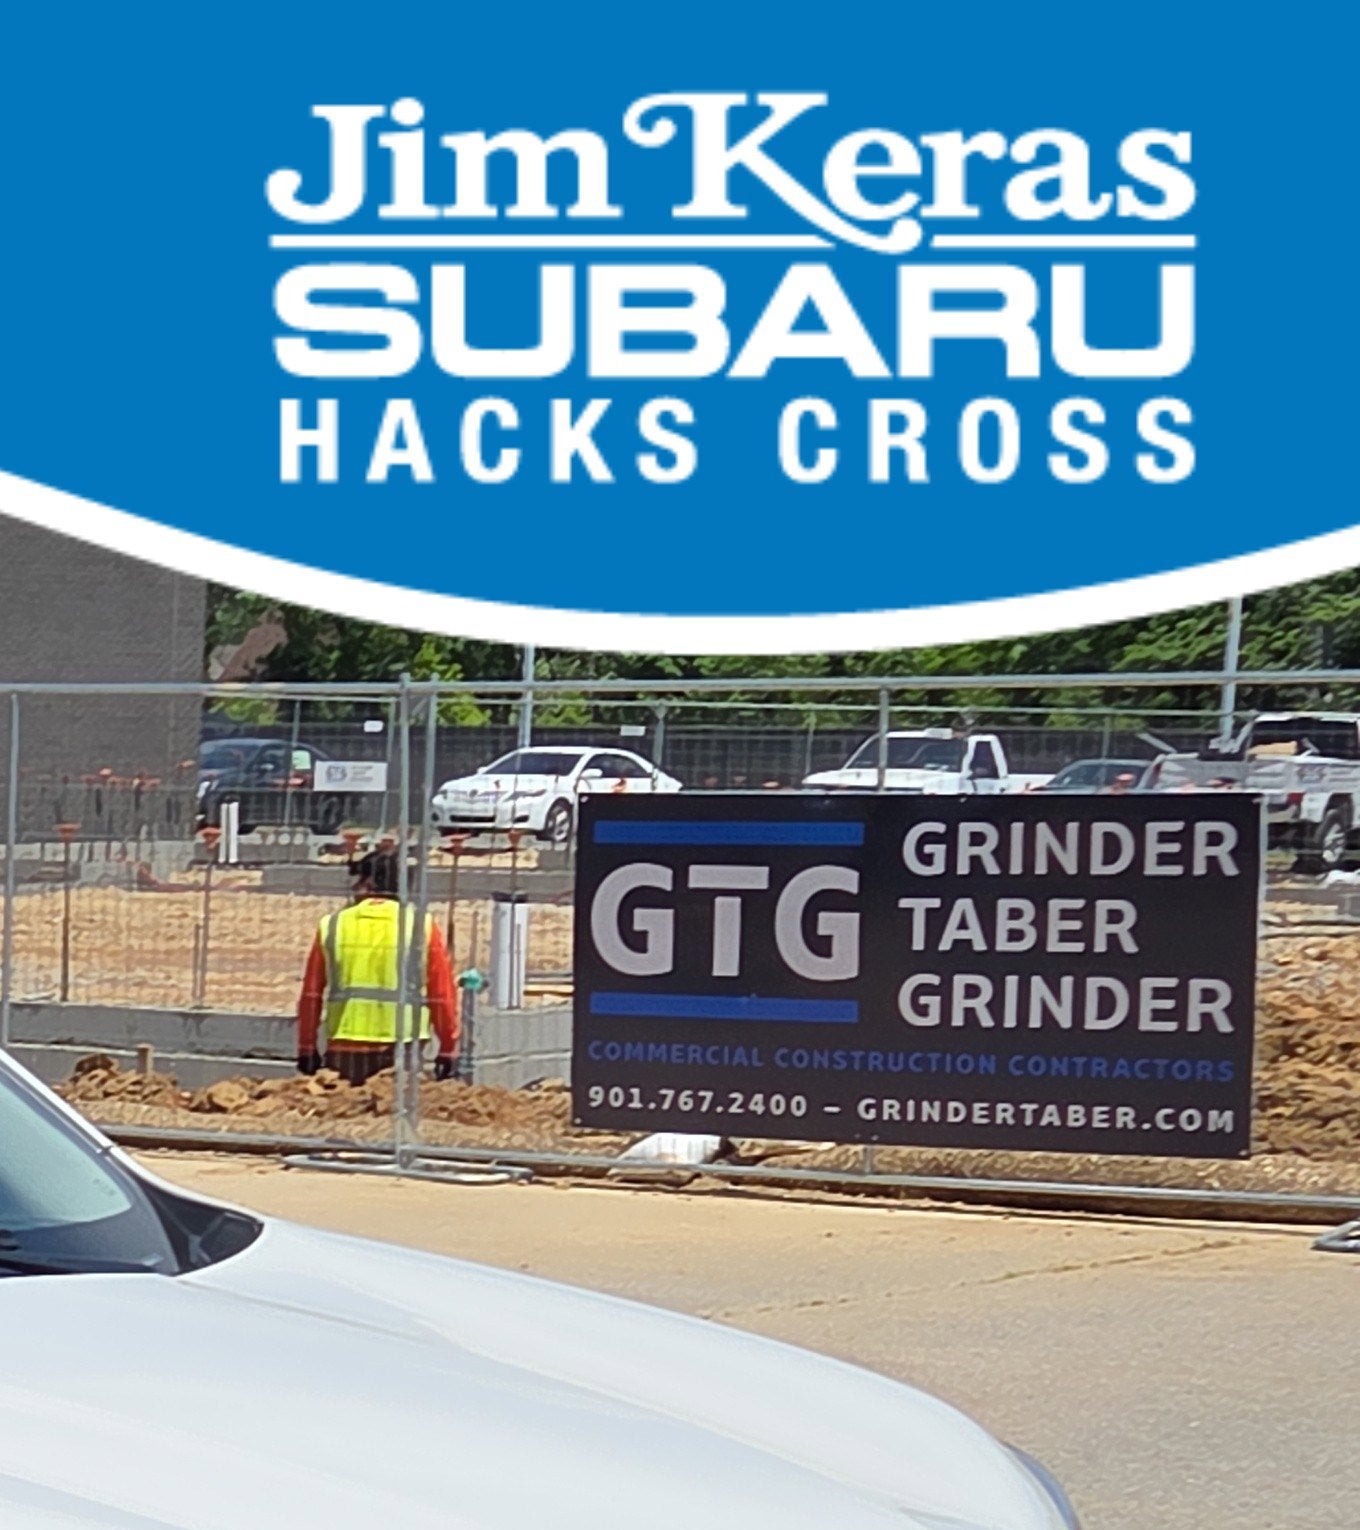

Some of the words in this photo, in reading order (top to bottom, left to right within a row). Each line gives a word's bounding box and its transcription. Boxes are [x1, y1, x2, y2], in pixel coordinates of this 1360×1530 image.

[902, 821, 1240, 876] GRINDER
[591, 863, 861, 981] GTG
[897, 898, 1139, 953] TABER
[897, 973, 1235, 1033] GRINDER
[588, 1040, 764, 1067] COMMERCIAL
[775, 1048, 997, 1075] CONSTRUCTION
[1007, 1054, 1236, 1083] CONTRACTORS
[589, 1085, 807, 1117] 901.767.2400
[857, 1098, 1235, 1133] GRINDERTABER.COM
